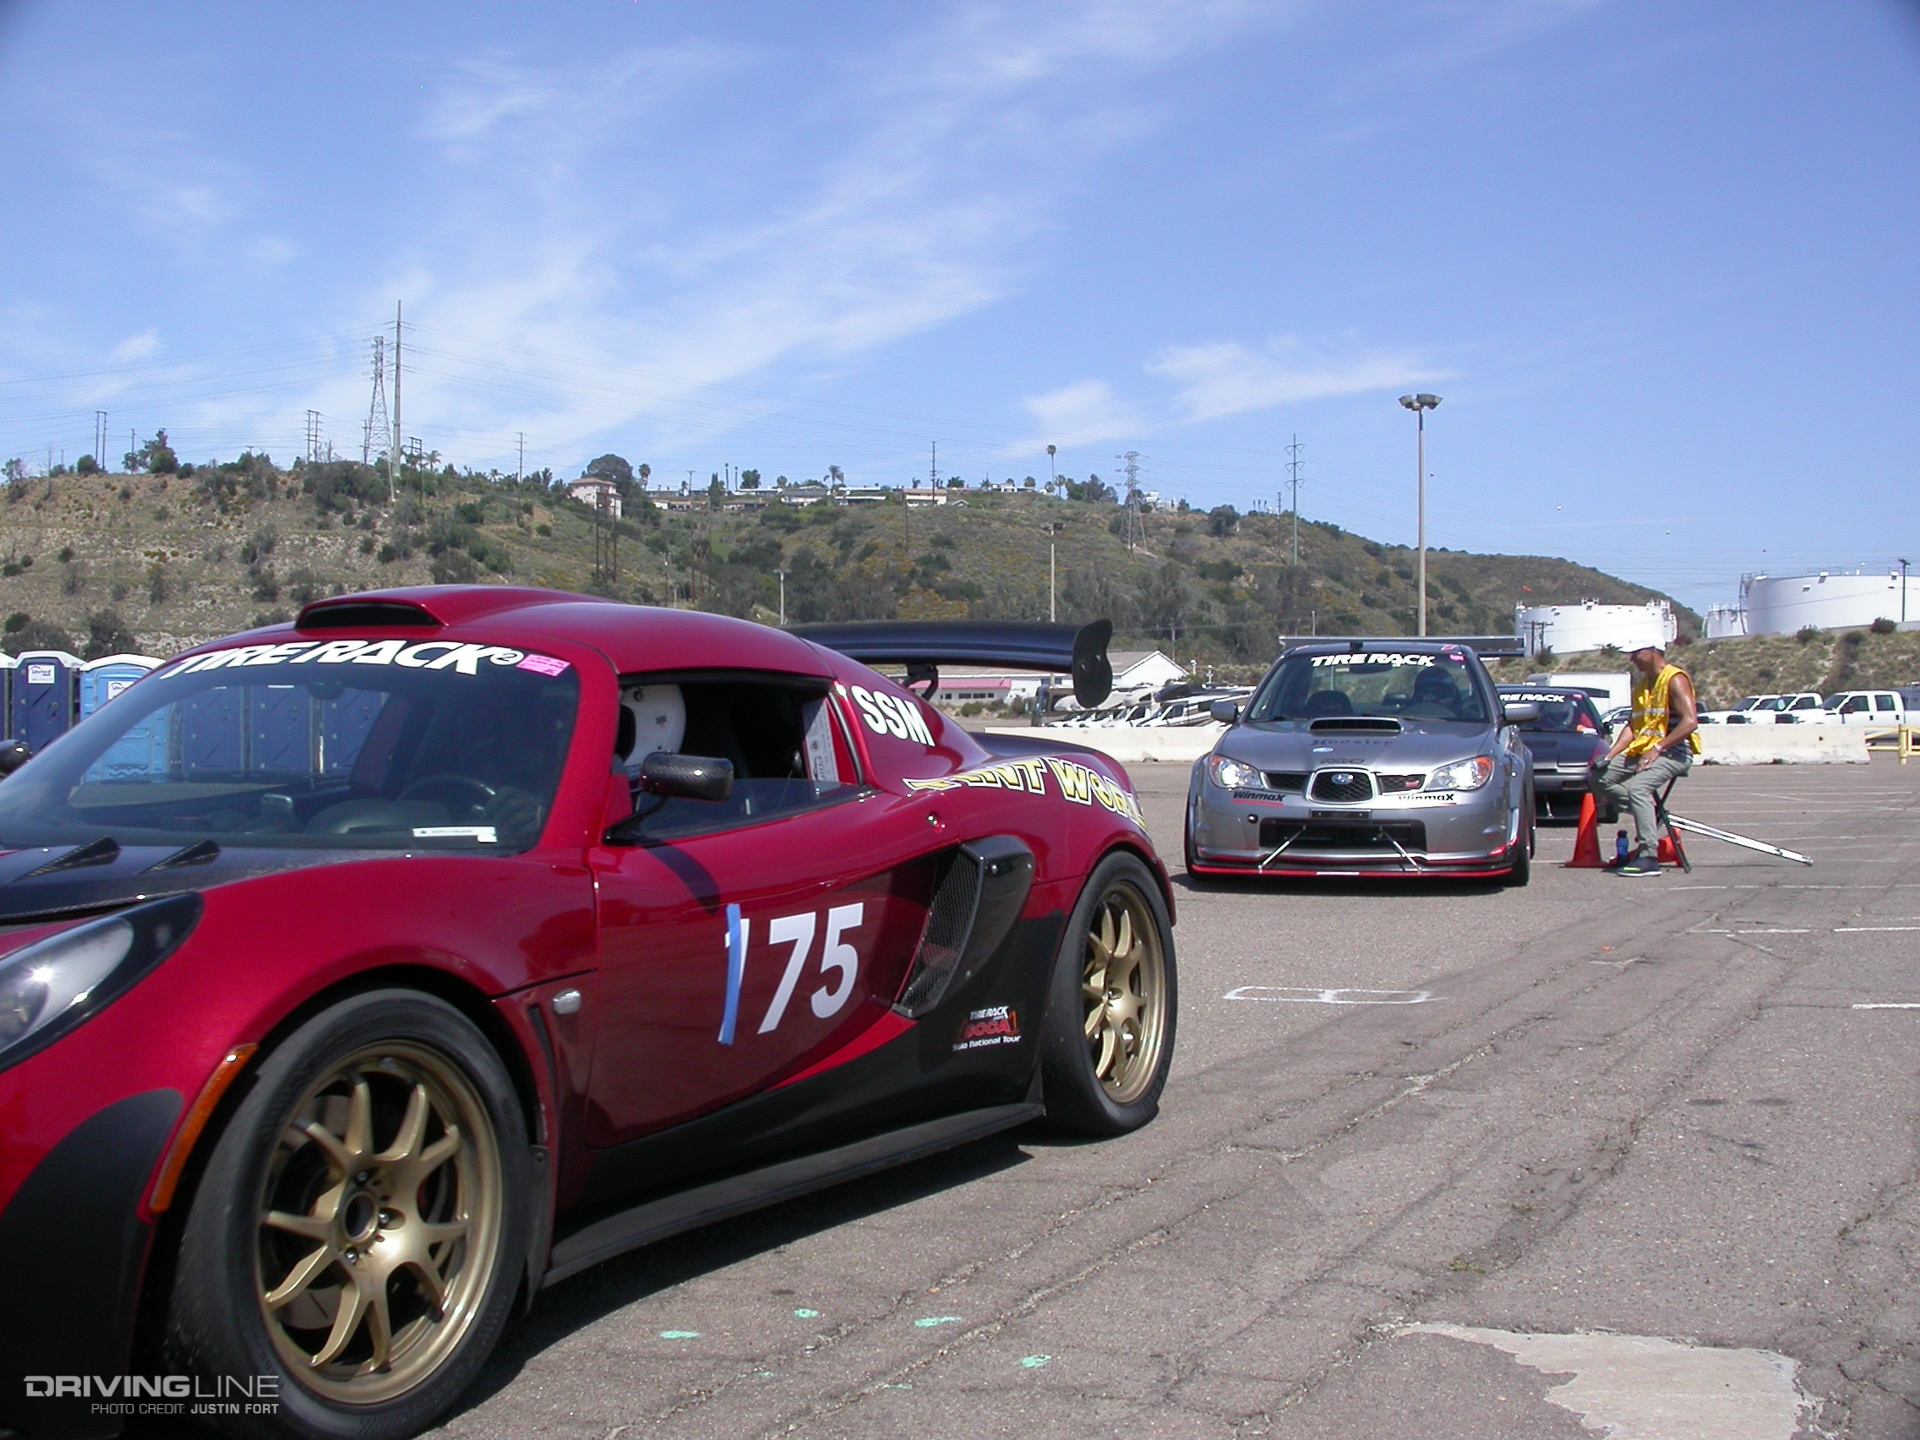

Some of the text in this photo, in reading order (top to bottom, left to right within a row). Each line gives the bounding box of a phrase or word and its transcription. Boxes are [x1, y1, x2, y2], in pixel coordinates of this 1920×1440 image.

[159, 642, 321, 680] TIRE
[289, 640, 512, 675] RACK
[1311, 654, 1435, 667] TIRE RACK
[1521, 694, 1565, 702] RACK
[851, 685, 936, 747] SSM
